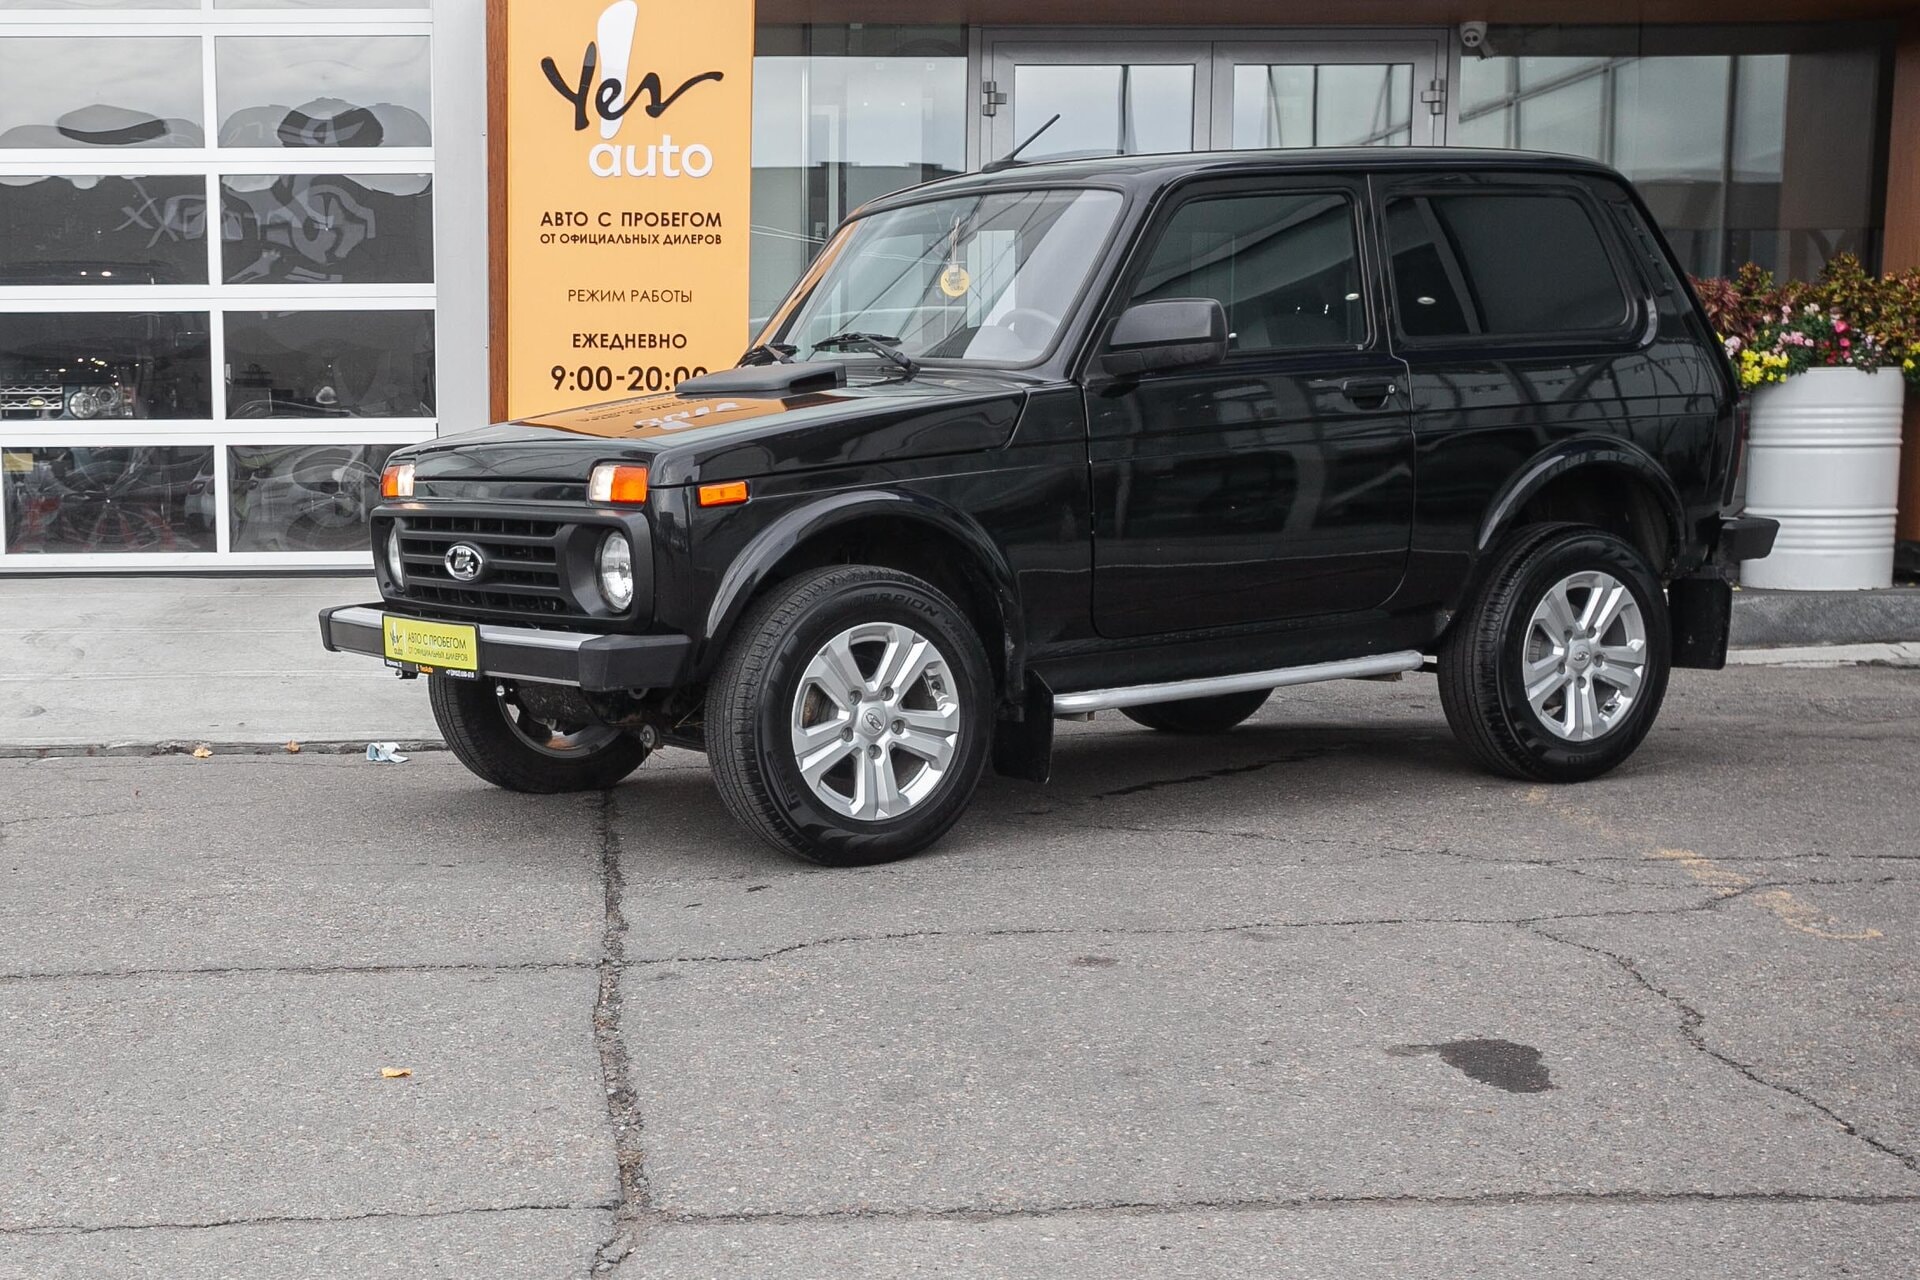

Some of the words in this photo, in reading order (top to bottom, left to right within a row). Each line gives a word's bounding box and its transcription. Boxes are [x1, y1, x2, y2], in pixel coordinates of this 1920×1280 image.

[540, 41, 724, 131] Yes
[588, 134, 714, 178] auto
[540, 211, 589, 227] АВТО
[597, 211, 612, 228] С
[621, 211, 722, 228] ПРОБЕГОМ
[540, 233, 556, 244] ОТ
[559, 233, 660, 246] ОФИЦИАЛЬНЫХ
[663, 234, 722, 246] ДИЛЕРОВ
[567, 289, 626, 302] РЕЖИМ
[630, 289, 693, 303] РАБОТЫ
[572, 333, 688, 351] ЕЖЕДНЕВНО
[407, 632, 422, 644] АВТО
[423, 633, 428, 645] С
[429, 635, 467, 650] ПРОБЕГОМ
